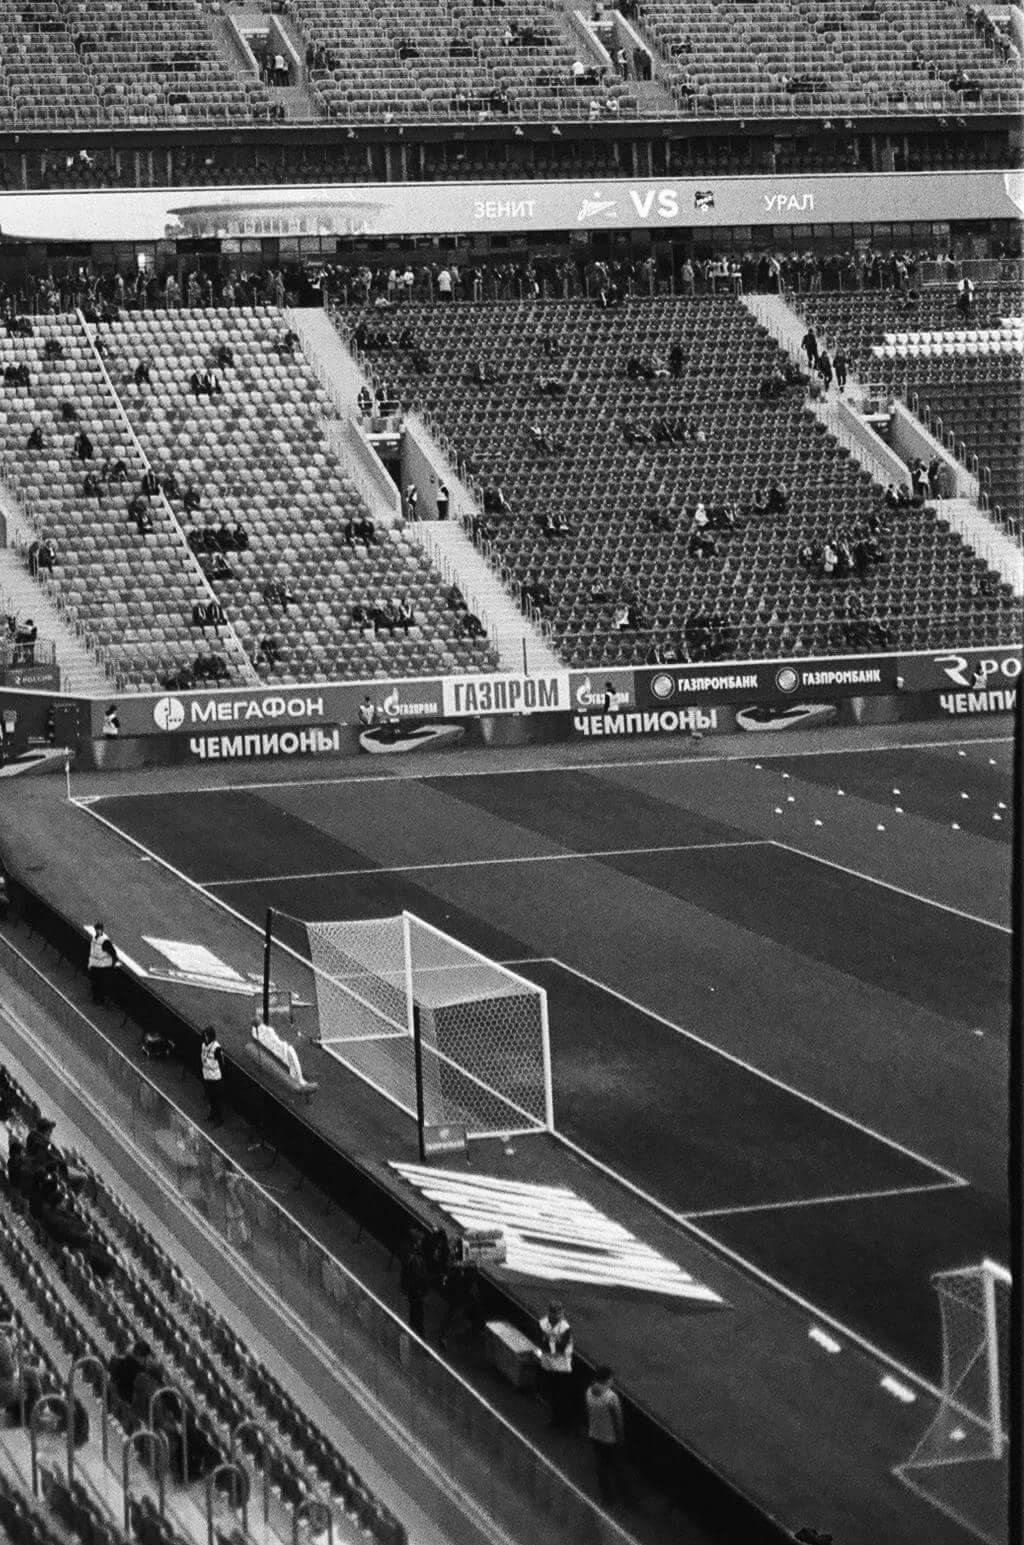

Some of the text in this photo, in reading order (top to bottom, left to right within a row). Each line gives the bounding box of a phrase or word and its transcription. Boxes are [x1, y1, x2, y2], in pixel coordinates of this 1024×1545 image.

[474, 199, 535, 219] ЗЕНИТ
[629, 188, 679, 219] VS
[763, 194, 815, 211] УРАЛ
[677, 675, 758, 692] ГАЗПРОМБАНК
[802, 669, 881, 686] ГАЗПРОМБАНК
[454, 678, 559, 712] ГАЗПРОМ
[574, 709, 717, 736] ЧЕМПИОНЫ
[190, 730, 340, 759] ЧЕМПИОНЫ
